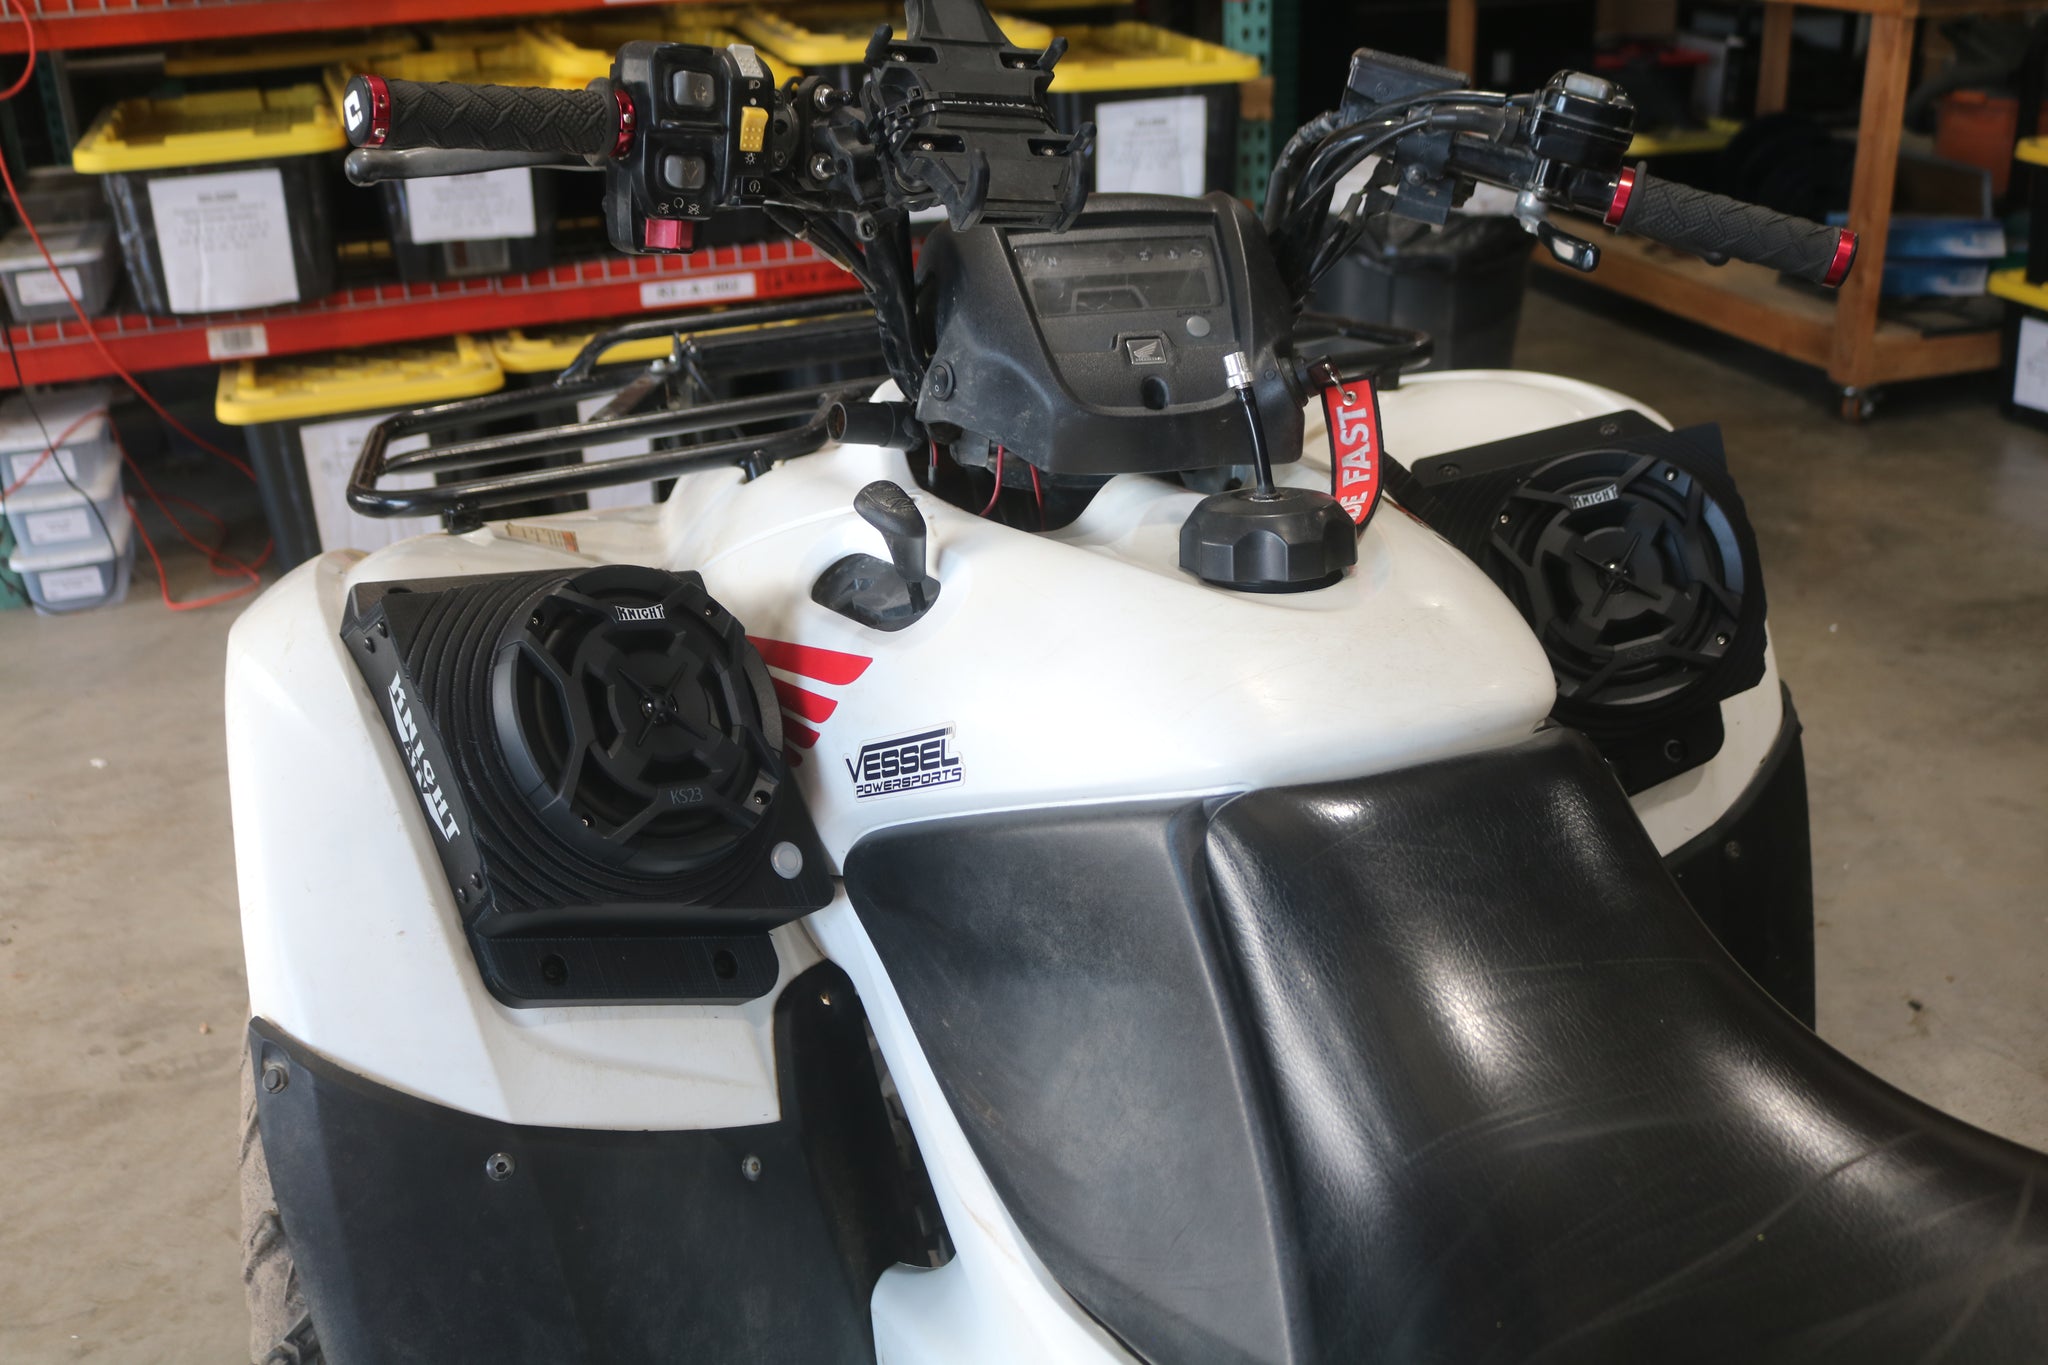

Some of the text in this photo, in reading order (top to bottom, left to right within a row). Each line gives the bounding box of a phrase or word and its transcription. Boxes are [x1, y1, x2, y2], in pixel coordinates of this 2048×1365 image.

[1336, 406, 1371, 488] FAST
[1571, 484, 1618, 509] KNIGHT
[615, 604, 665, 620] KNIGHT
[390, 670, 461, 840] KNIGHT
[846, 730, 959, 783] VESSEL
[856, 767, 962, 795] POWERSPORTS
[670, 787, 703, 805] KS23
